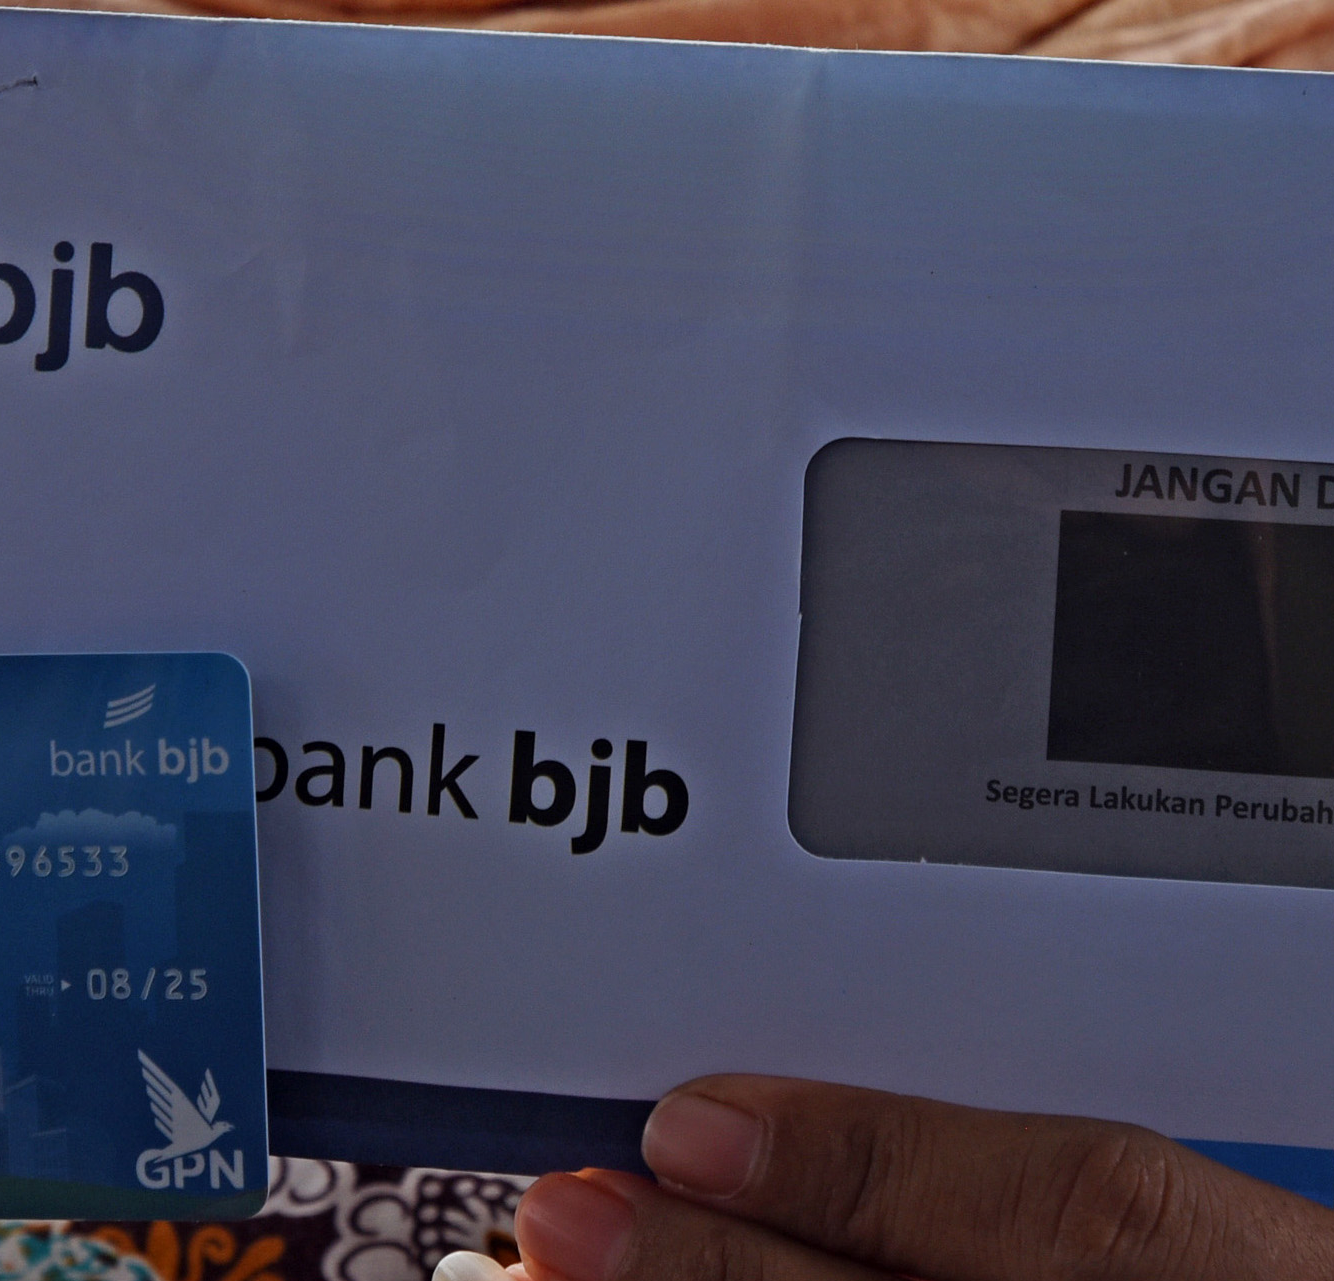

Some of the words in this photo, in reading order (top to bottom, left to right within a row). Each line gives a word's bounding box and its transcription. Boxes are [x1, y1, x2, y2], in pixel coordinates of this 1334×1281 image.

[1115, 463, 1301, 509] JANGAN
[49, 739, 147, 777] bank
[158, 737, 231, 784] bjb
[508, 729, 690, 855] bjb
[985, 778, 1080, 810] Segera
[1089, 785, 1205, 816] Lakukan
[135, 1148, 245, 1190] GPN
